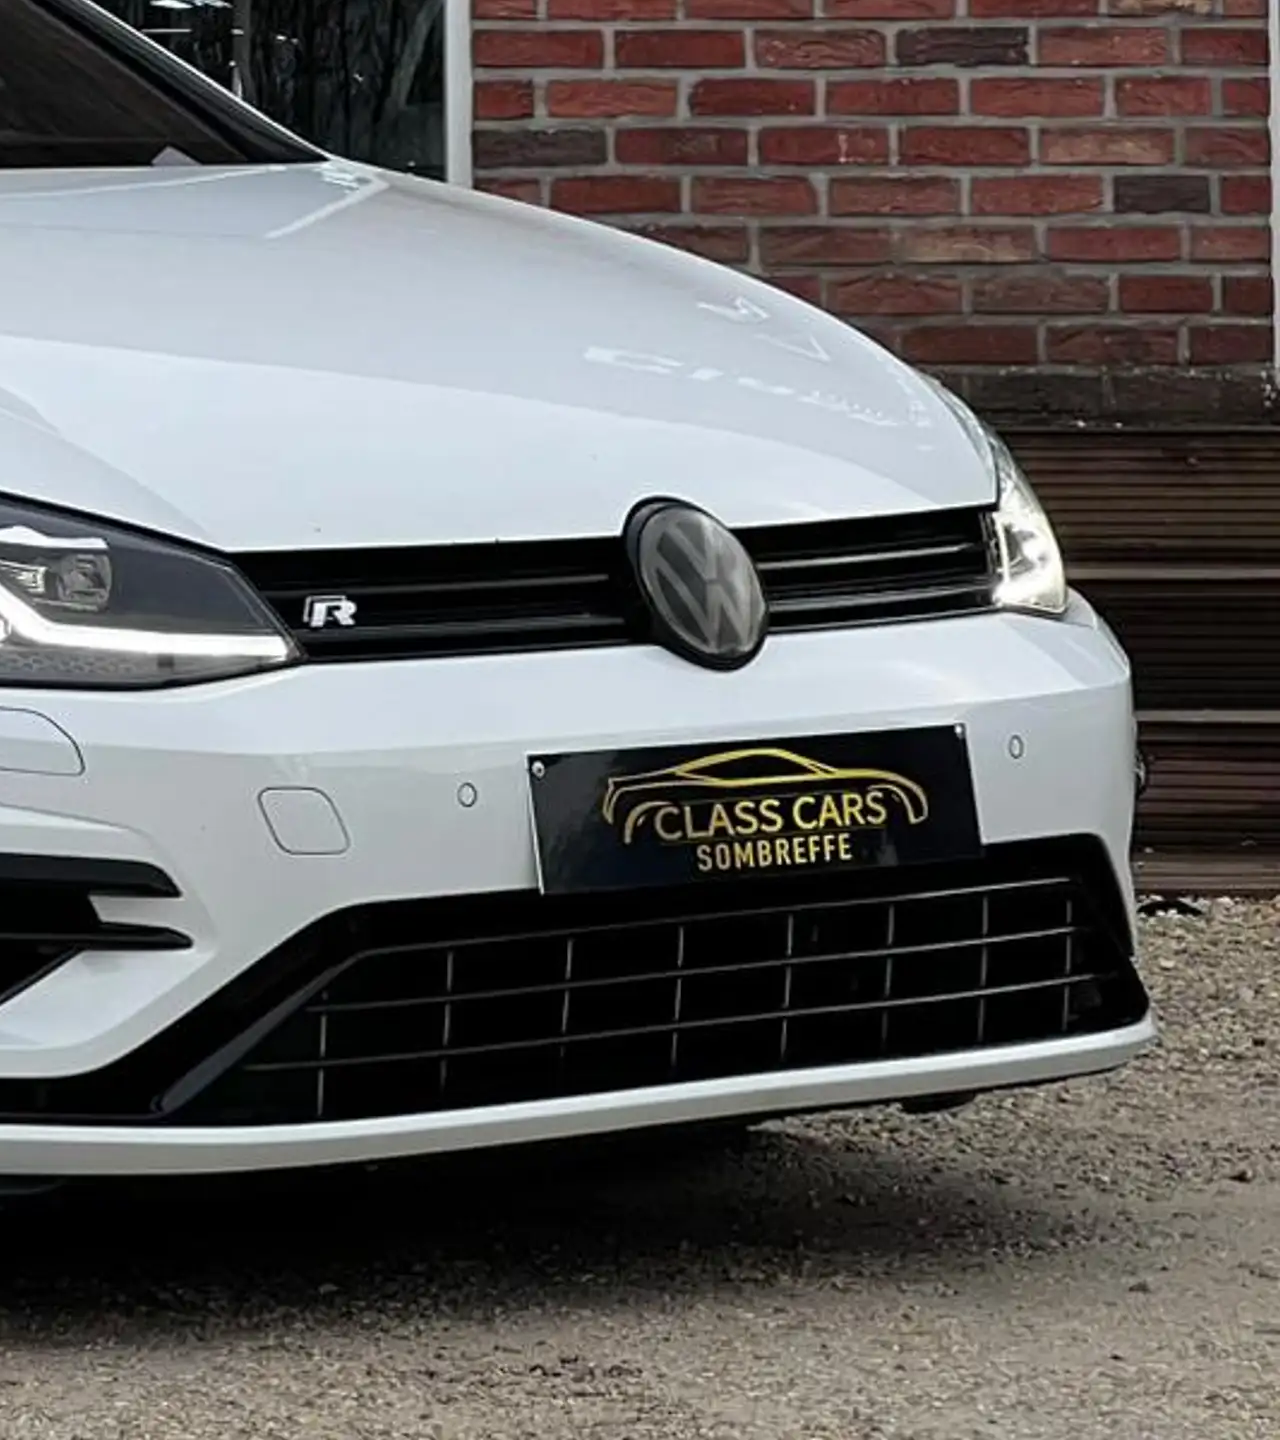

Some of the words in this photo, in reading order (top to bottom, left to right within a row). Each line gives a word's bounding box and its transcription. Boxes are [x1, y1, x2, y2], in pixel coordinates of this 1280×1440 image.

[303, 595, 357, 627] R
[654, 798, 784, 841] CLASS
[792, 791, 887, 832] CARS
[696, 833, 853, 872] SOMBREFFE
